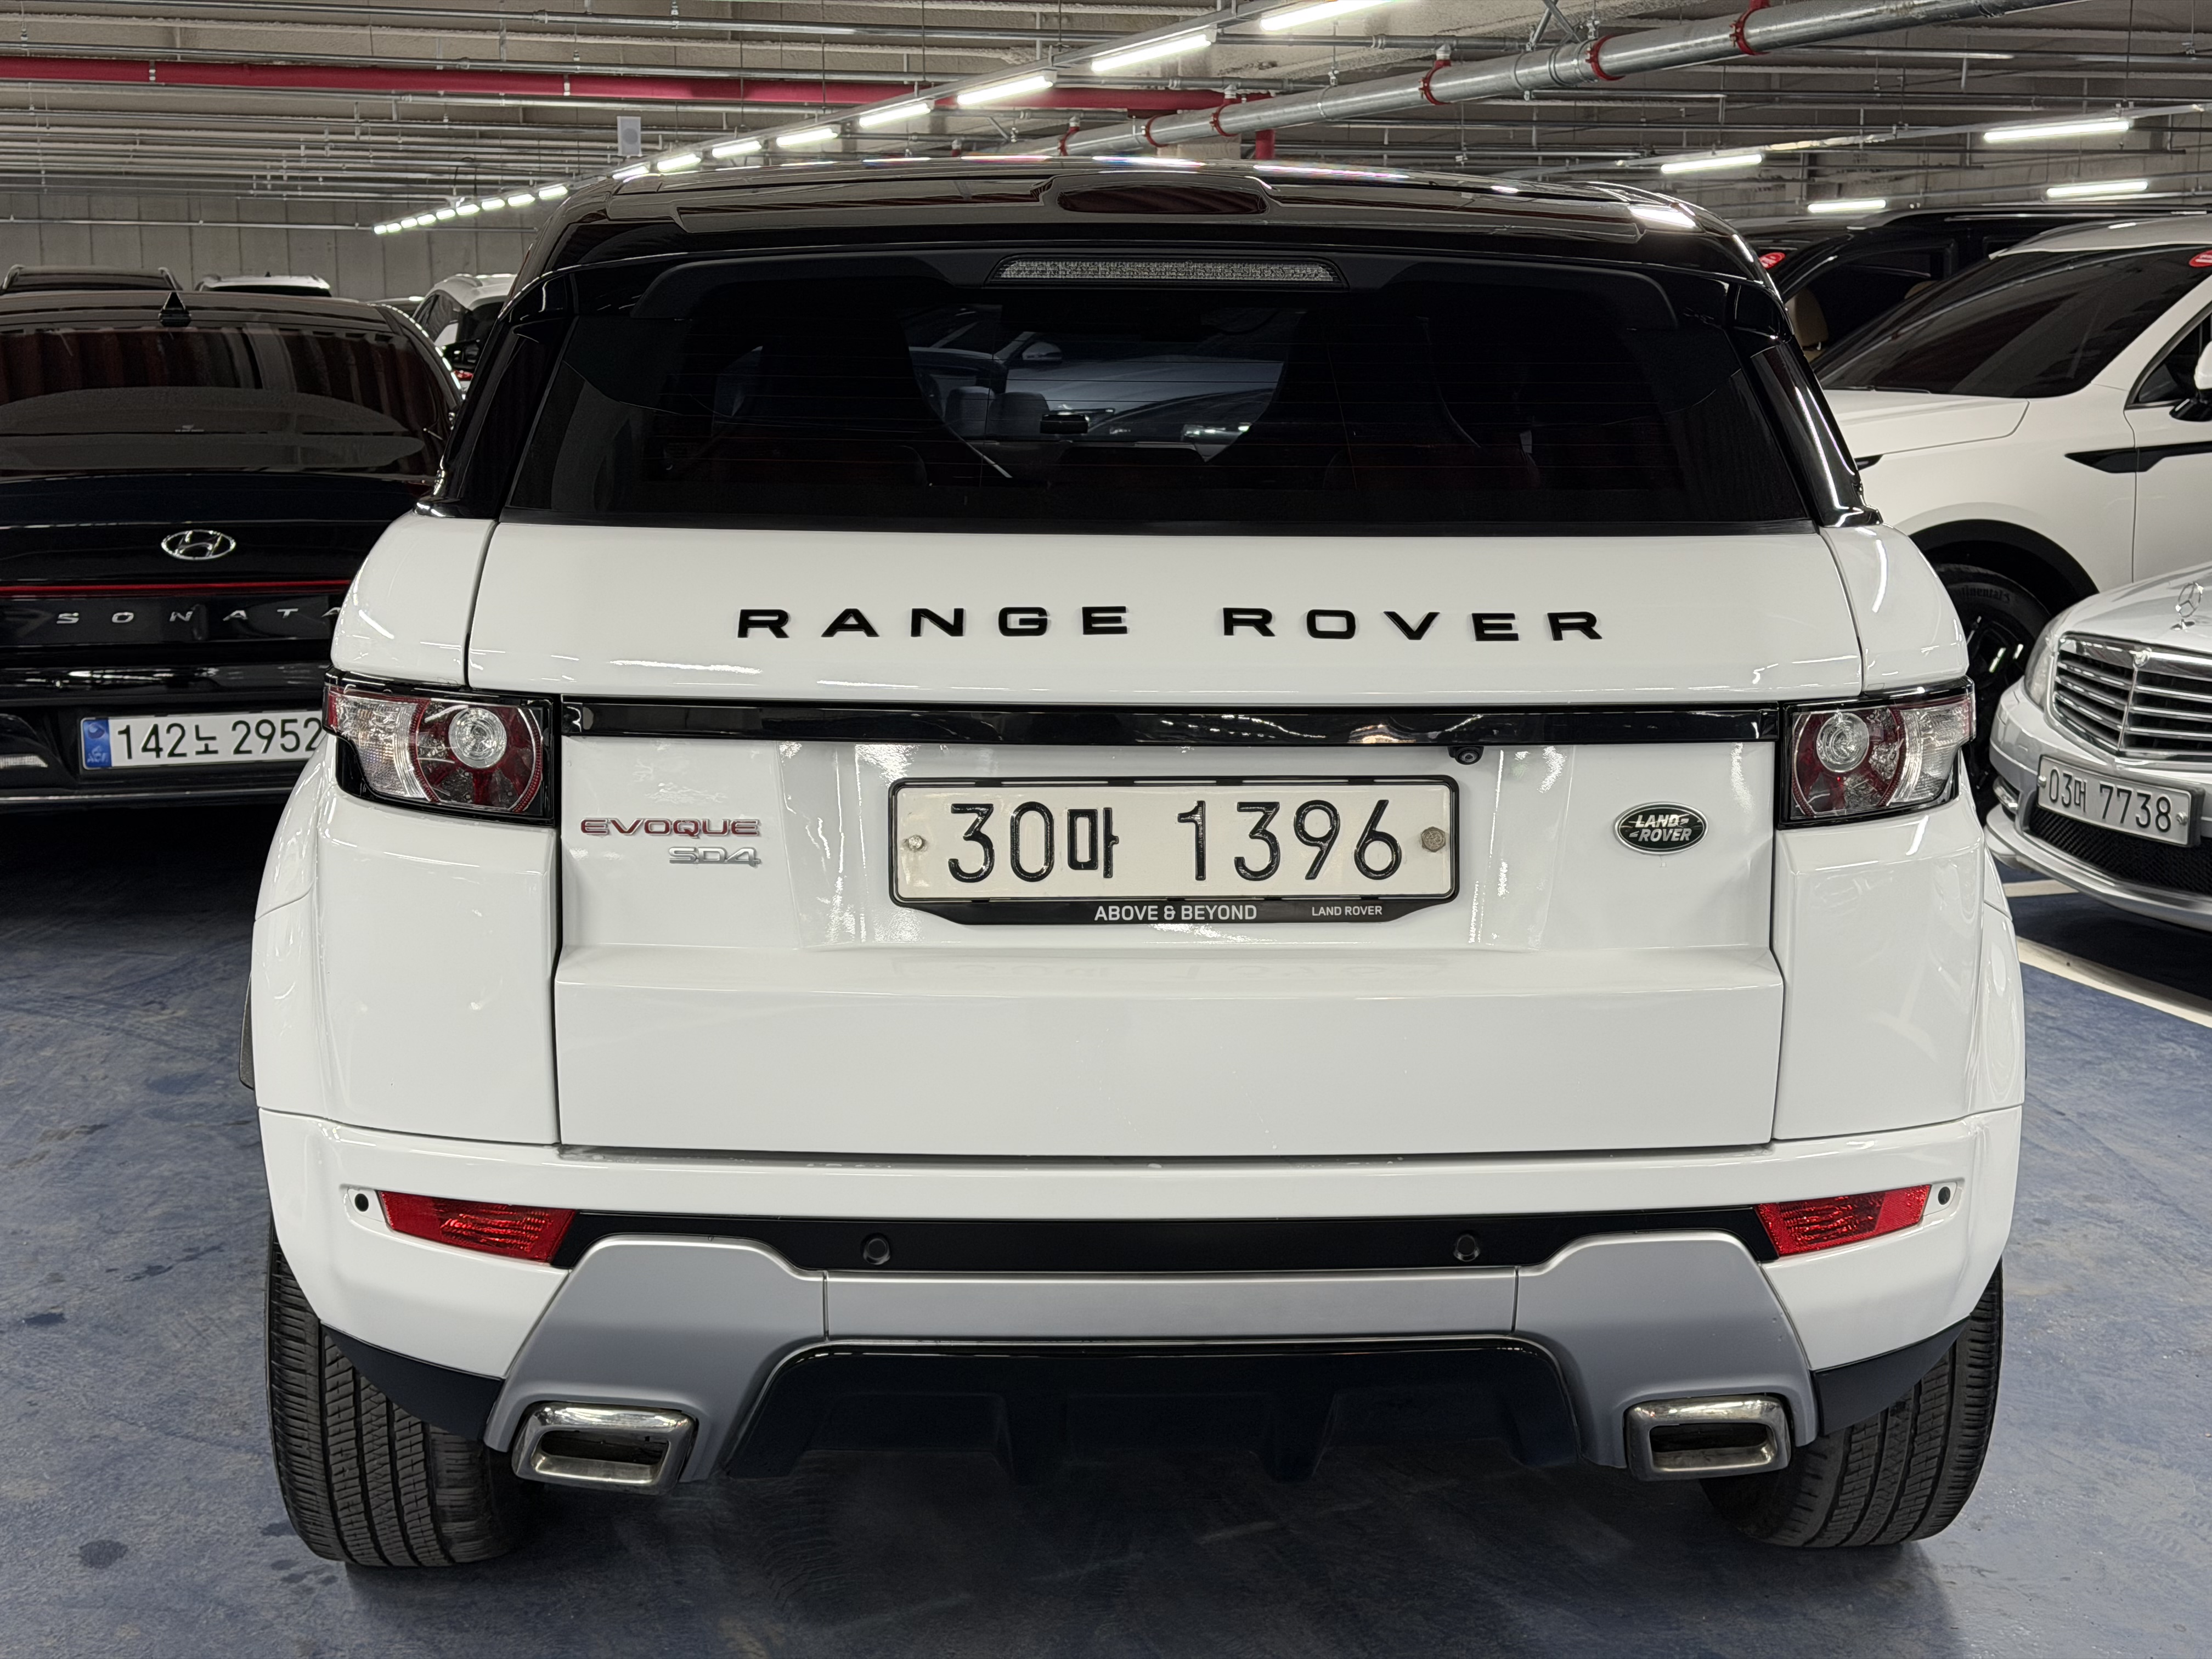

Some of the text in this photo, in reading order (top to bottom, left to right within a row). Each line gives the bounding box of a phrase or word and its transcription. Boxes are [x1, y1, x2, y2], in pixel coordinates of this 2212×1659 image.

[57, 607, 341, 624] SONATA
[737, 606, 1603, 641] RANGE ROVER
[117, 717, 322, 760] 142노 2952
[2049, 768, 2171, 832] 03머 7738
[580, 818, 759, 838] EVOQUE
[1635, 815, 1680, 828] LAND
[948, 799, 1402, 883] 30마 1396
[1638, 828, 1692, 842] ROVER
[668, 847, 760, 867] SD4
[1094, 905, 1257, 921] ABOVE & BEYOND
[1312, 906, 1383, 916] LAND ROVER
